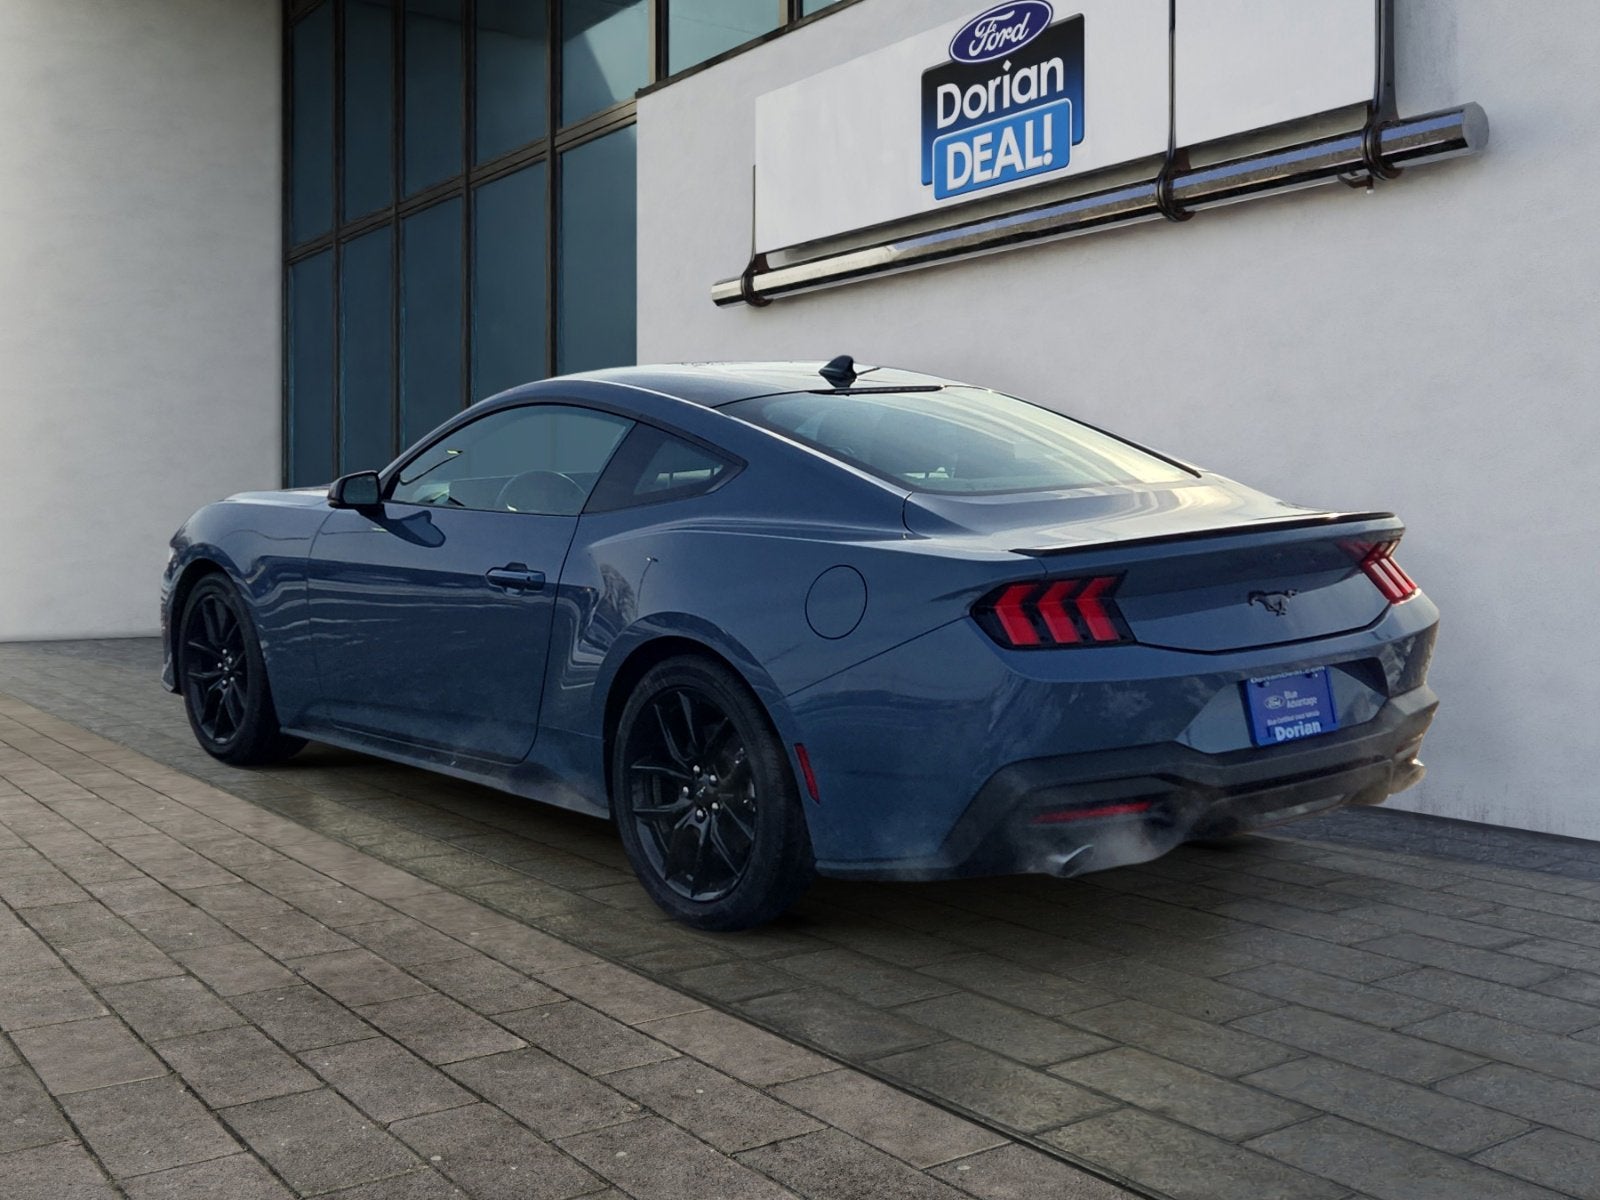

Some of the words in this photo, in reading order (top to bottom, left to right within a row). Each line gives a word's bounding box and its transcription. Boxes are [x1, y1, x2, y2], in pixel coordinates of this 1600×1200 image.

[968, 10, 1031, 57] Ford
[937, 57, 1064, 130] Dorian
[947, 113, 1053, 191] DEAL!
[1275, 721, 1321, 742] Dorian
